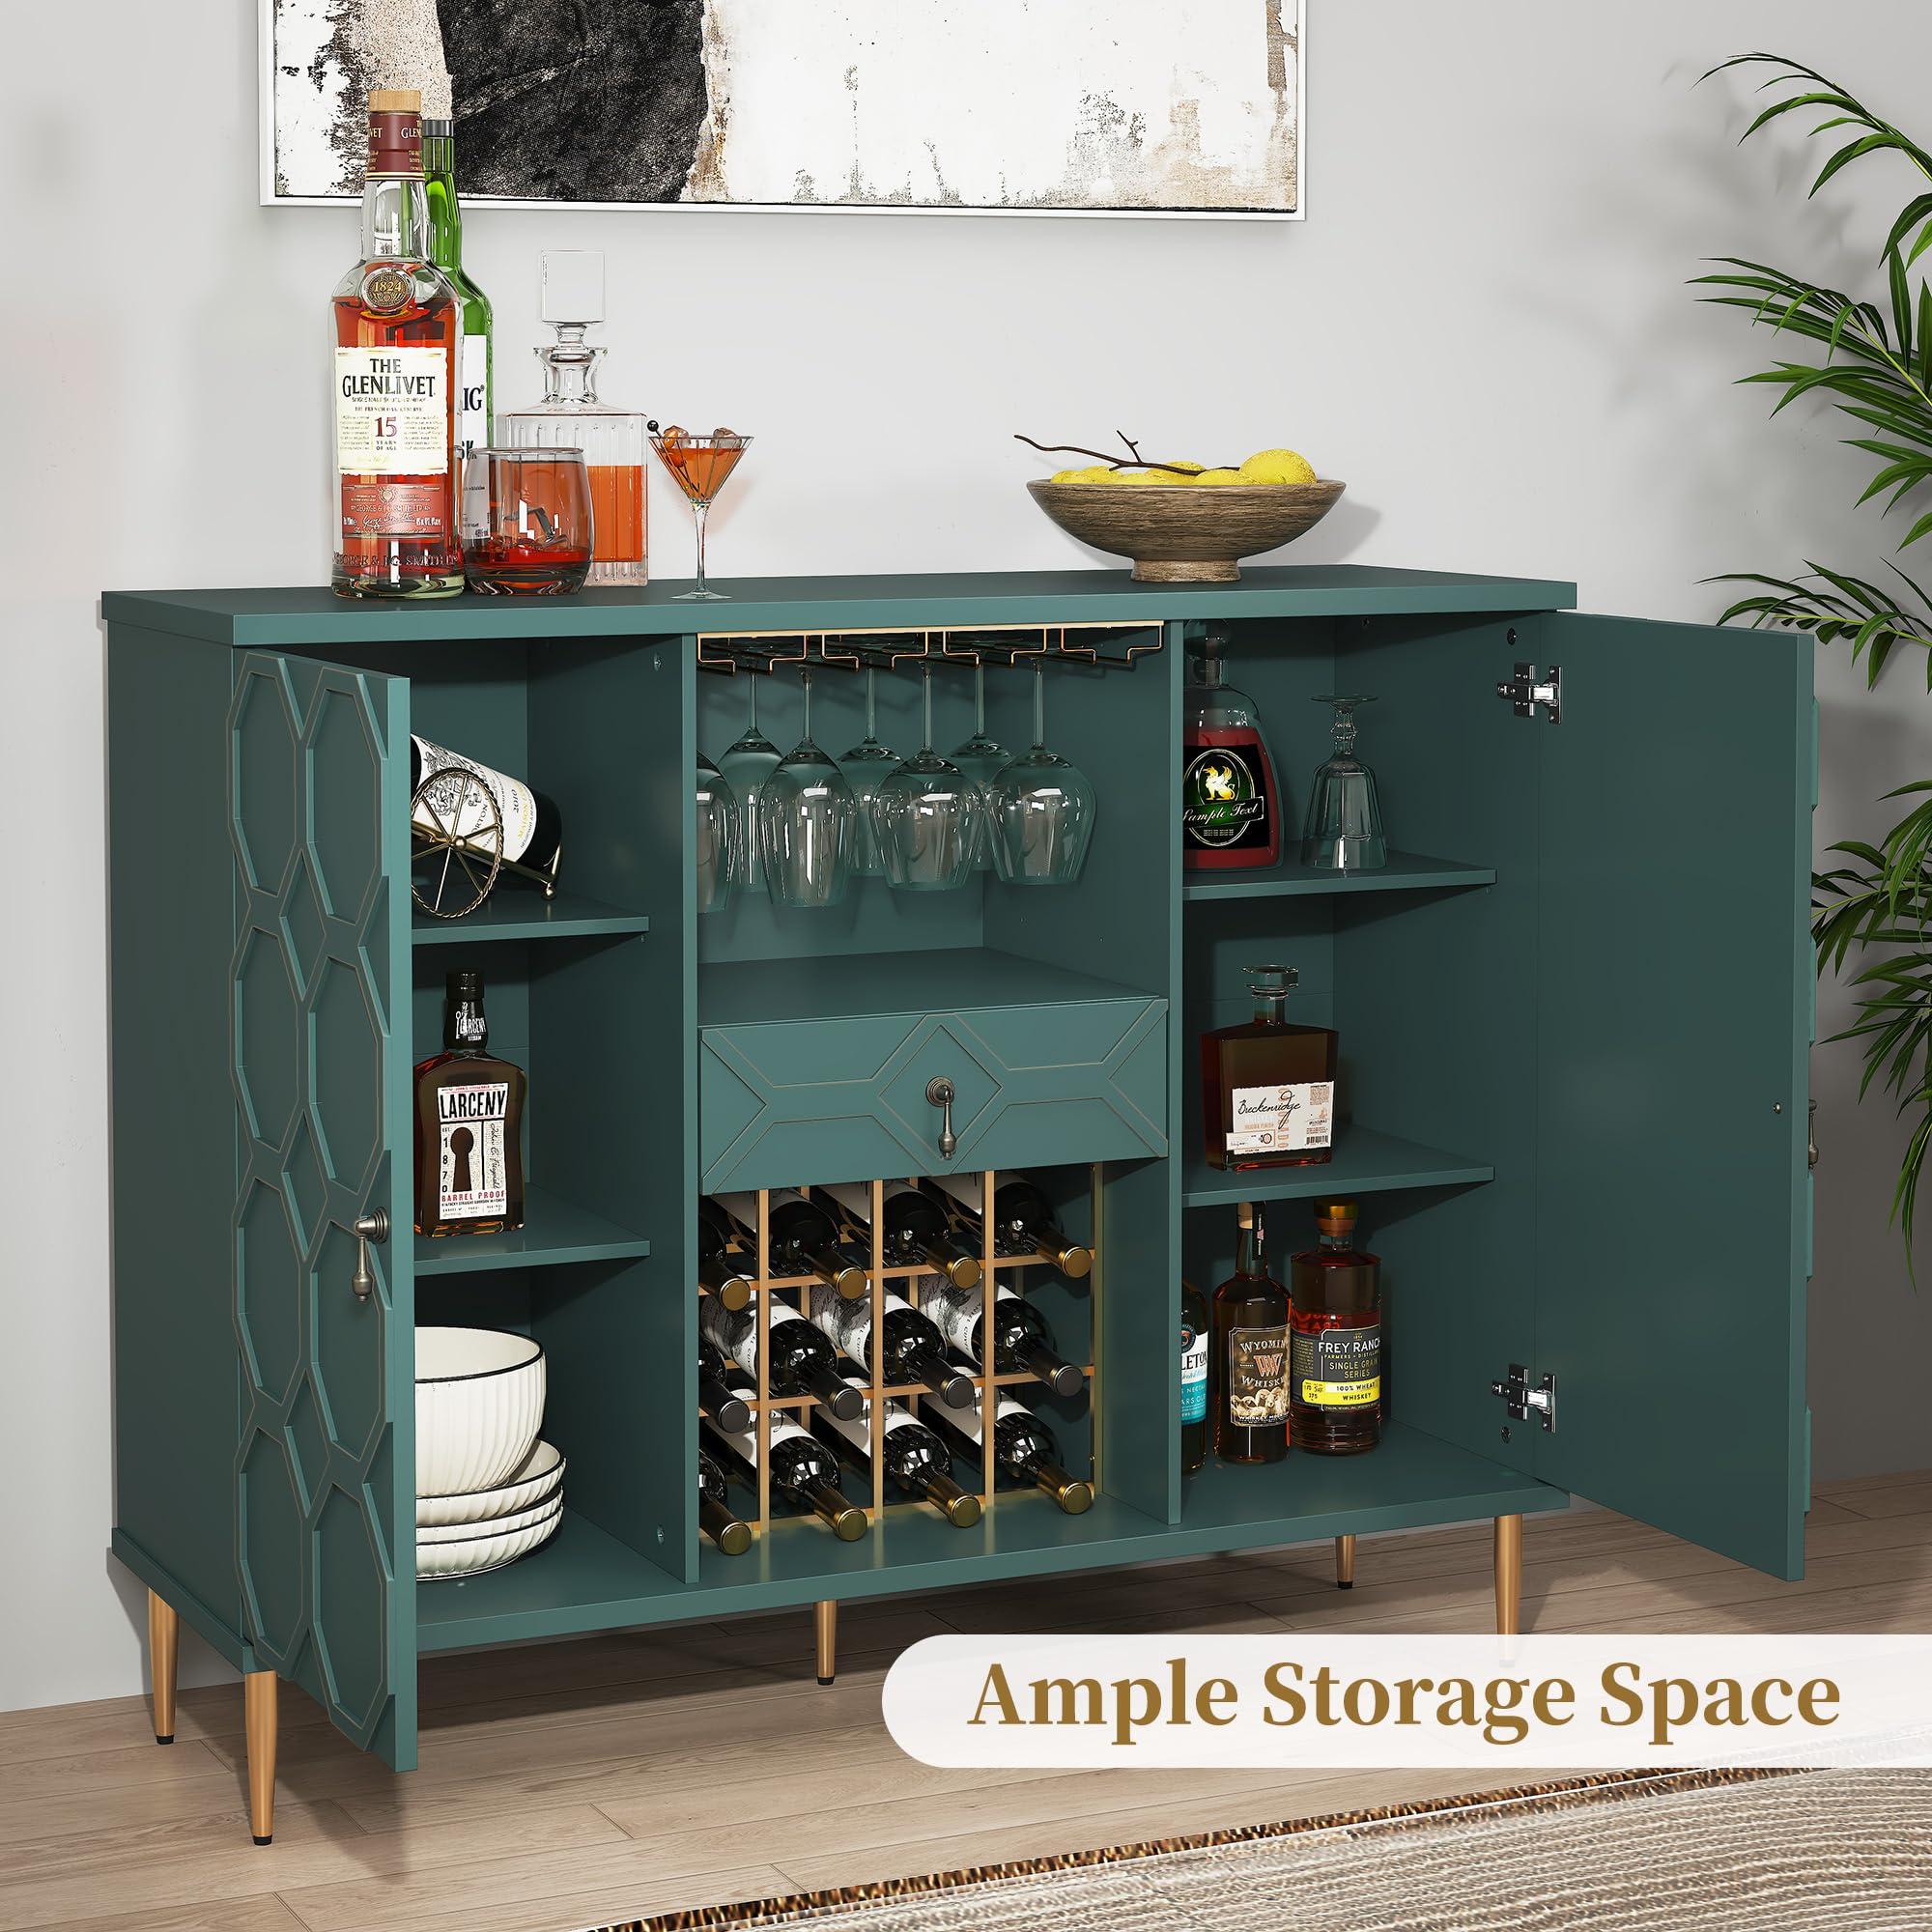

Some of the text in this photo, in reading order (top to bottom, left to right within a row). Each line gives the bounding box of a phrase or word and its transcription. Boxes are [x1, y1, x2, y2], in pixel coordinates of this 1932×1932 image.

[374, 281, 402, 292] 1824
[369, 358, 402, 374] THE
[342, 375, 436, 397] GLENLIVET
[375, 416, 398, 438] 15
[440, 1090, 506, 1120] LARCENY
[441, 1190, 505, 1203] BARREL PROOF
[1319, 1342, 1350, 1353] FREY
[1329, 1361, 1359, 1370] SINGLE
[1344, 1369, 1370, 1379] SERIES
[1356, 1381, 1376, 1390] WHEAT
[1343, 1392, 1372, 1401] WHISKEY
